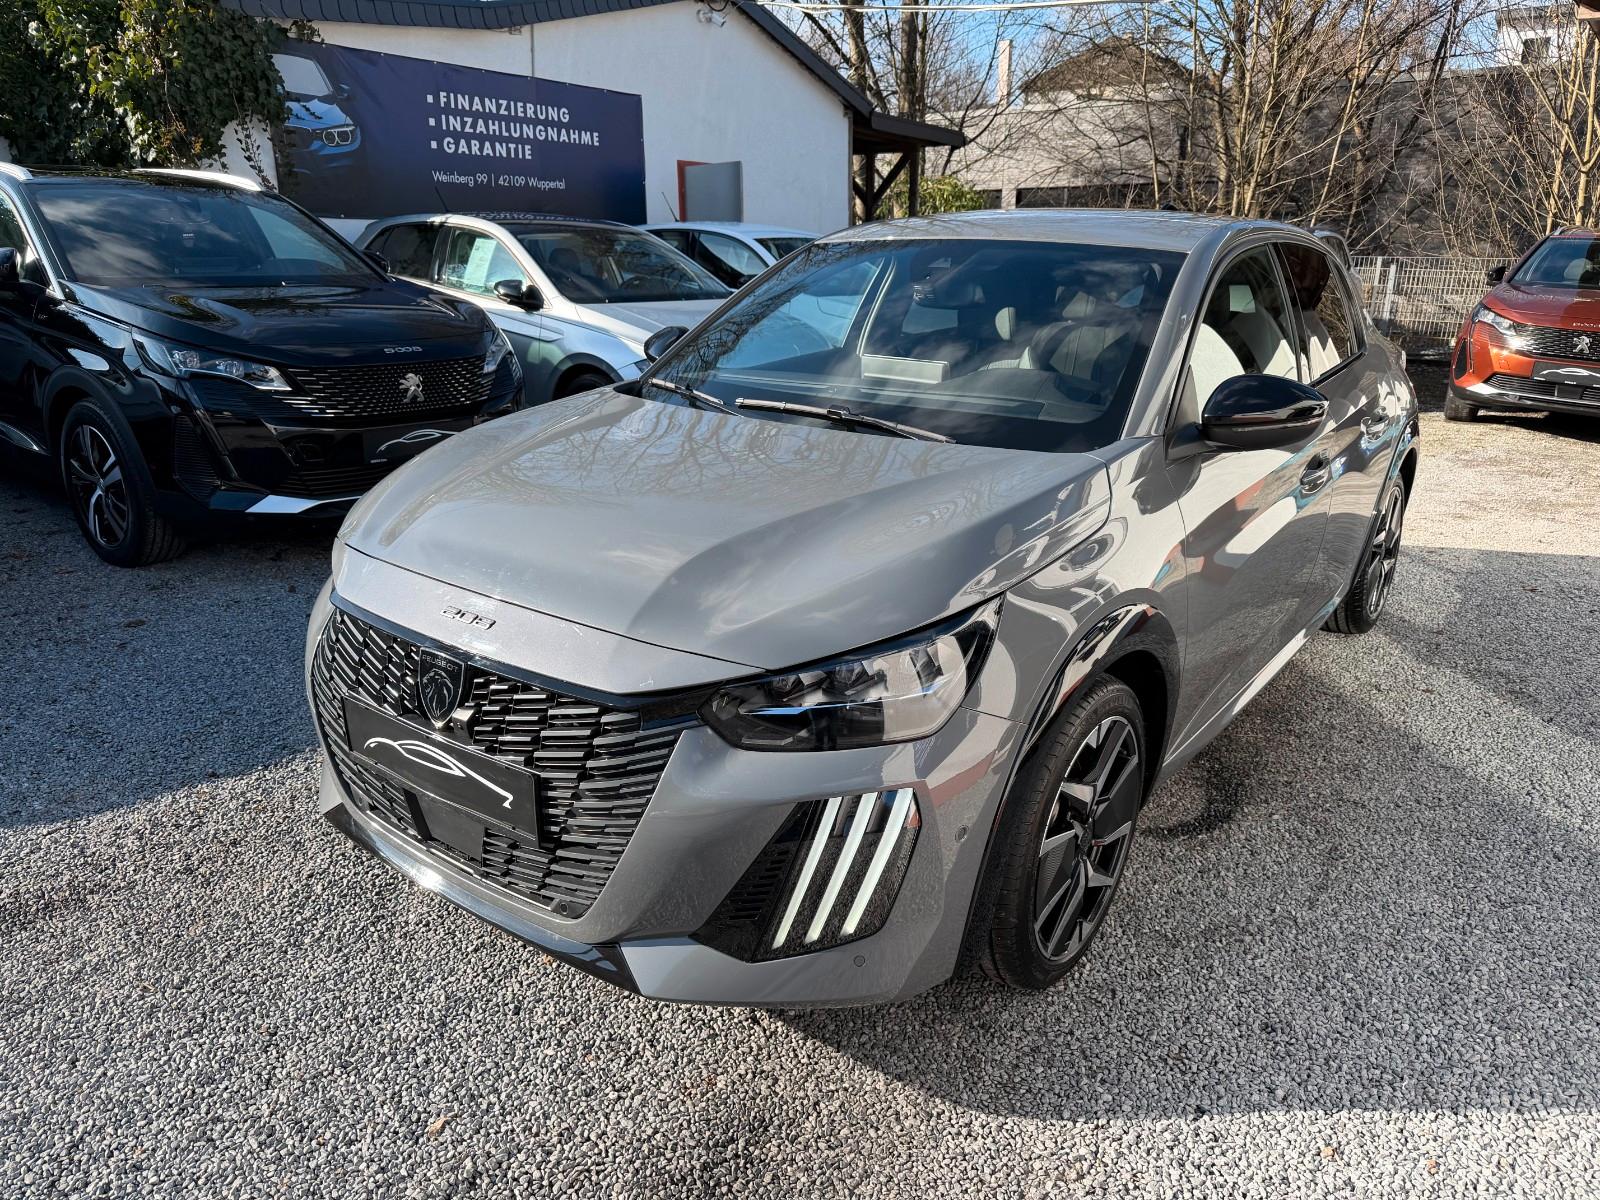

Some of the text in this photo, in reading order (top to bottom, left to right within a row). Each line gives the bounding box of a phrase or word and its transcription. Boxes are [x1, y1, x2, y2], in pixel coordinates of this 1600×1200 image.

[439, 91, 570, 122] FINANZIERUNG
[441, 115, 600, 147] INZAHLUNGNAHME
[443, 137, 532, 160] GARANTIE
[432, 170, 474, 187] Weinberg
[476, 173, 488, 185] 99
[498, 175, 526, 187] 42109
[527, 177, 566, 190] Wuppertal
[440, 605, 497, 630] 208
[422, 654, 459, 673] PEUGEOT
